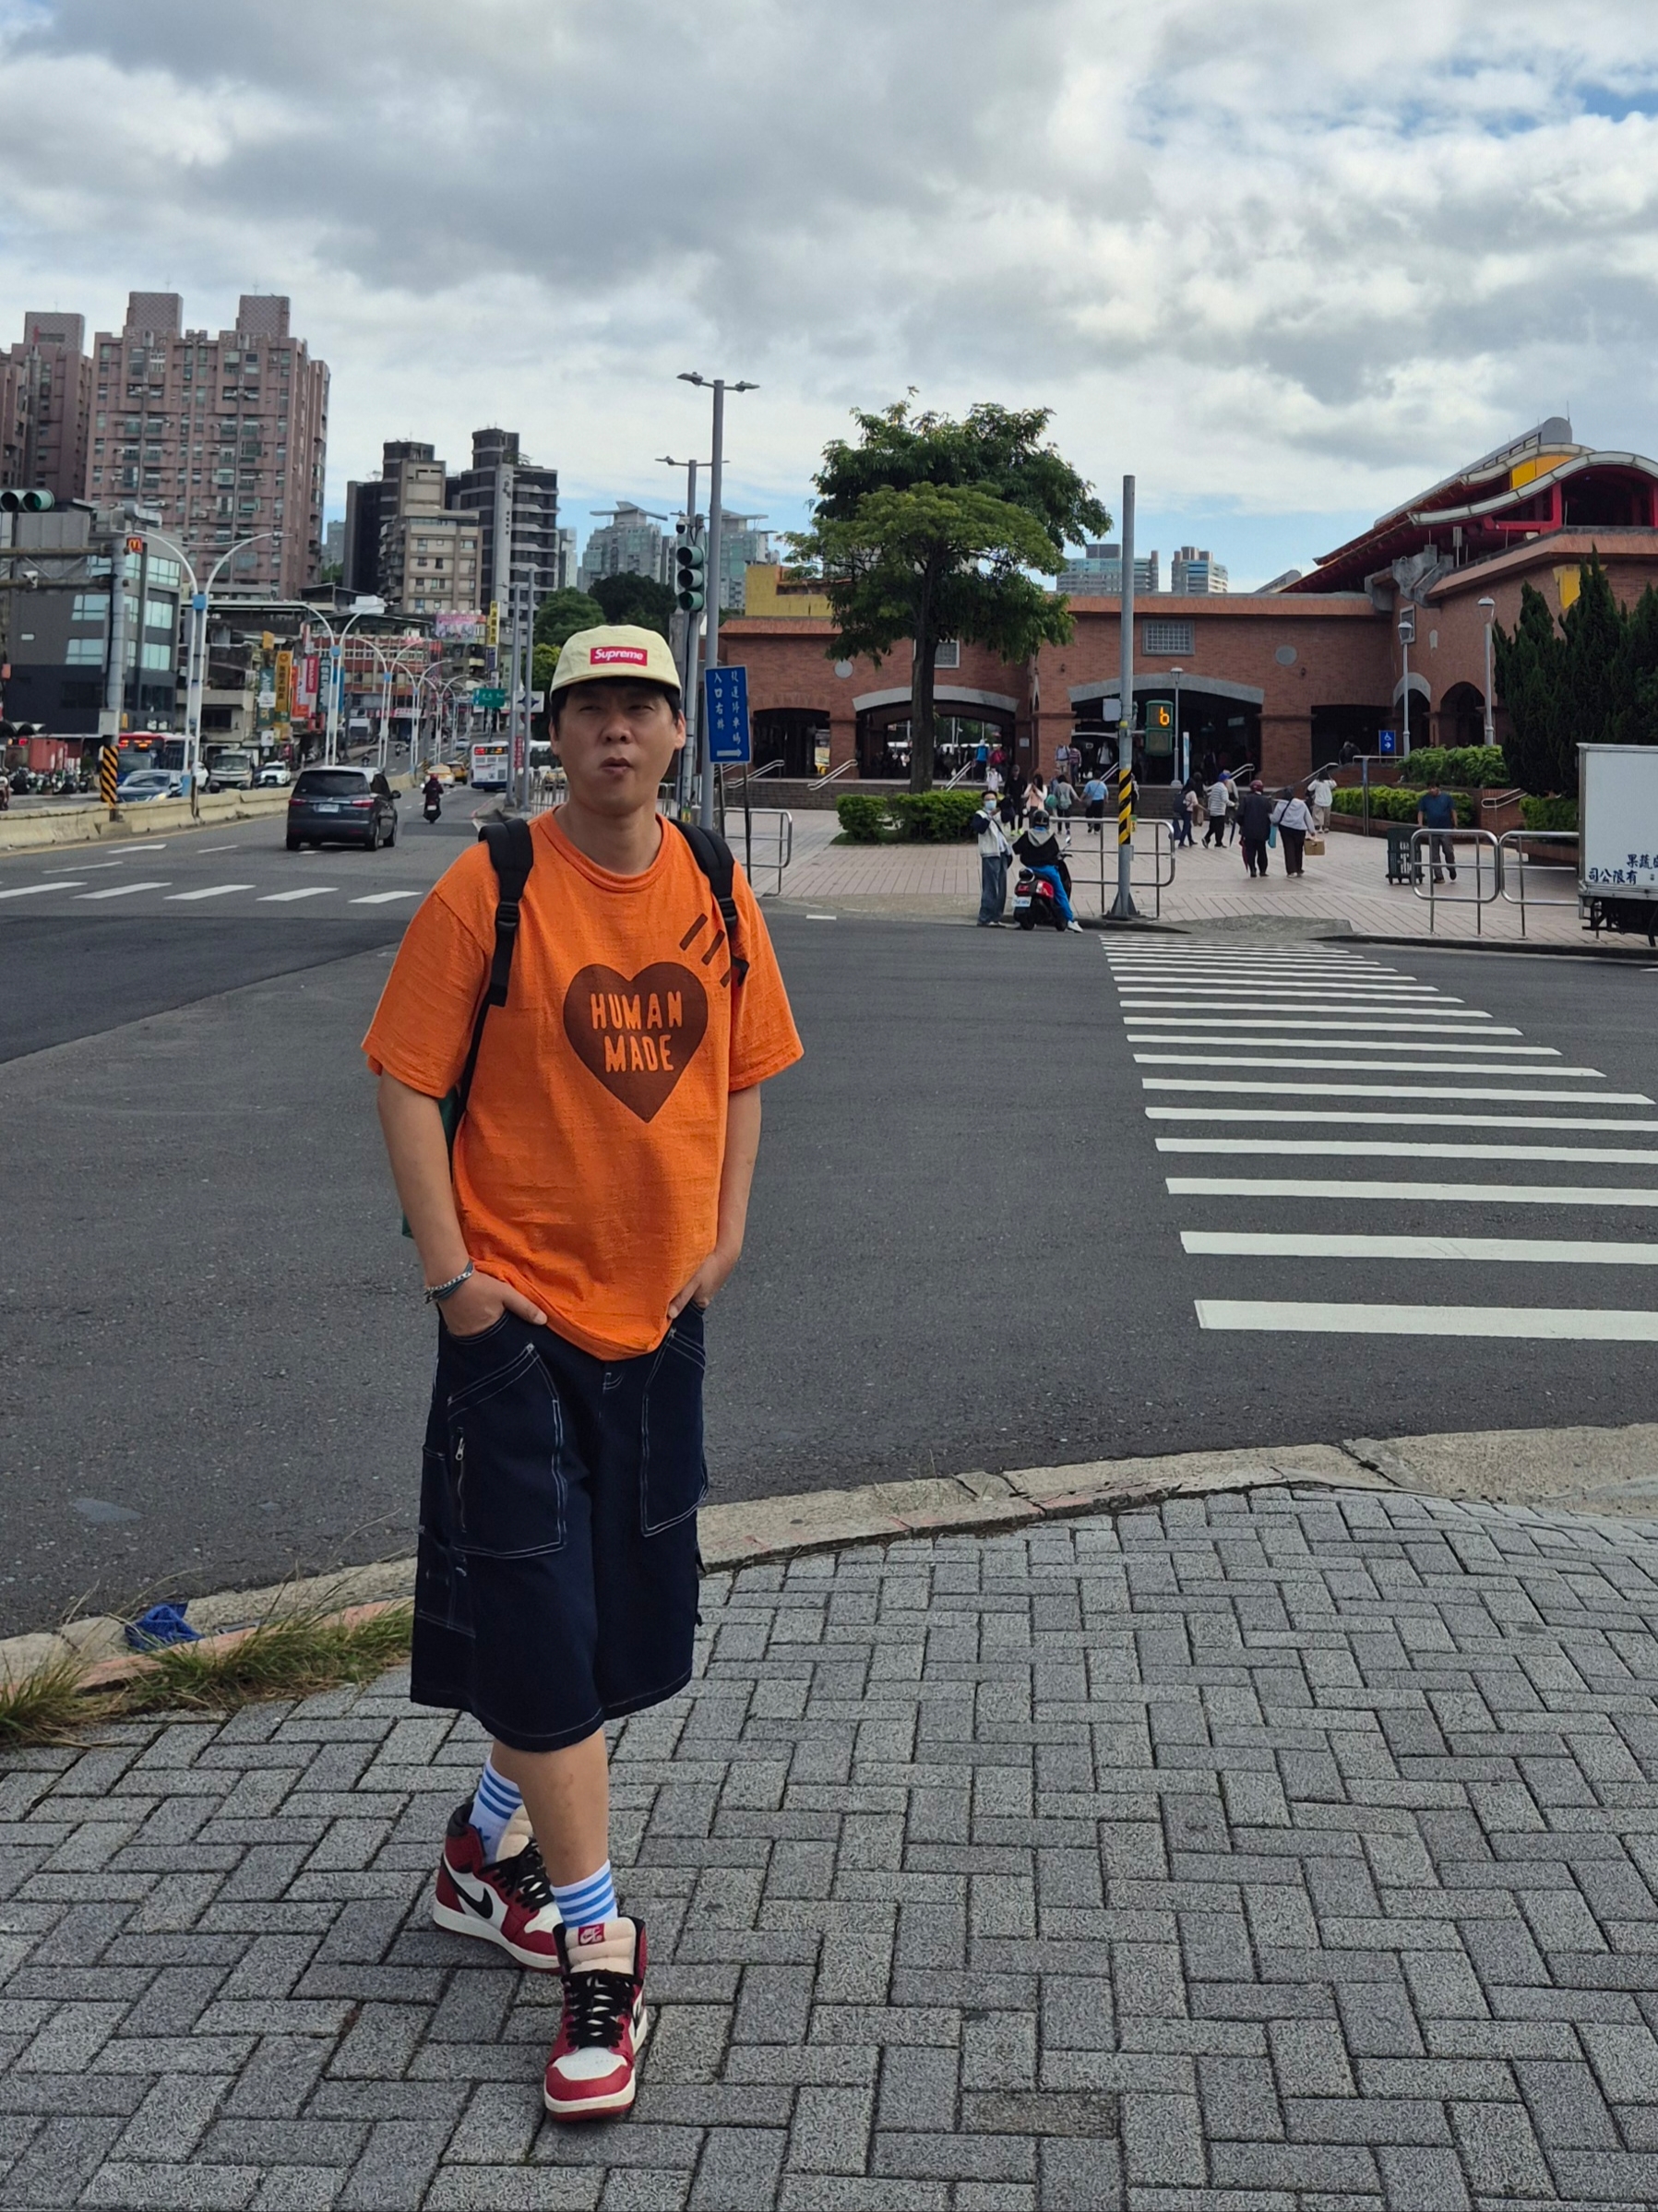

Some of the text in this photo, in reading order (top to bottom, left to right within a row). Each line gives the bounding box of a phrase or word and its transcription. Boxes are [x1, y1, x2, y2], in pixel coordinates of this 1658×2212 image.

[594, 649, 644, 661] Supreme
[590, 990, 683, 1030] HUMAN
[604, 1034, 674, 1072] MADE
